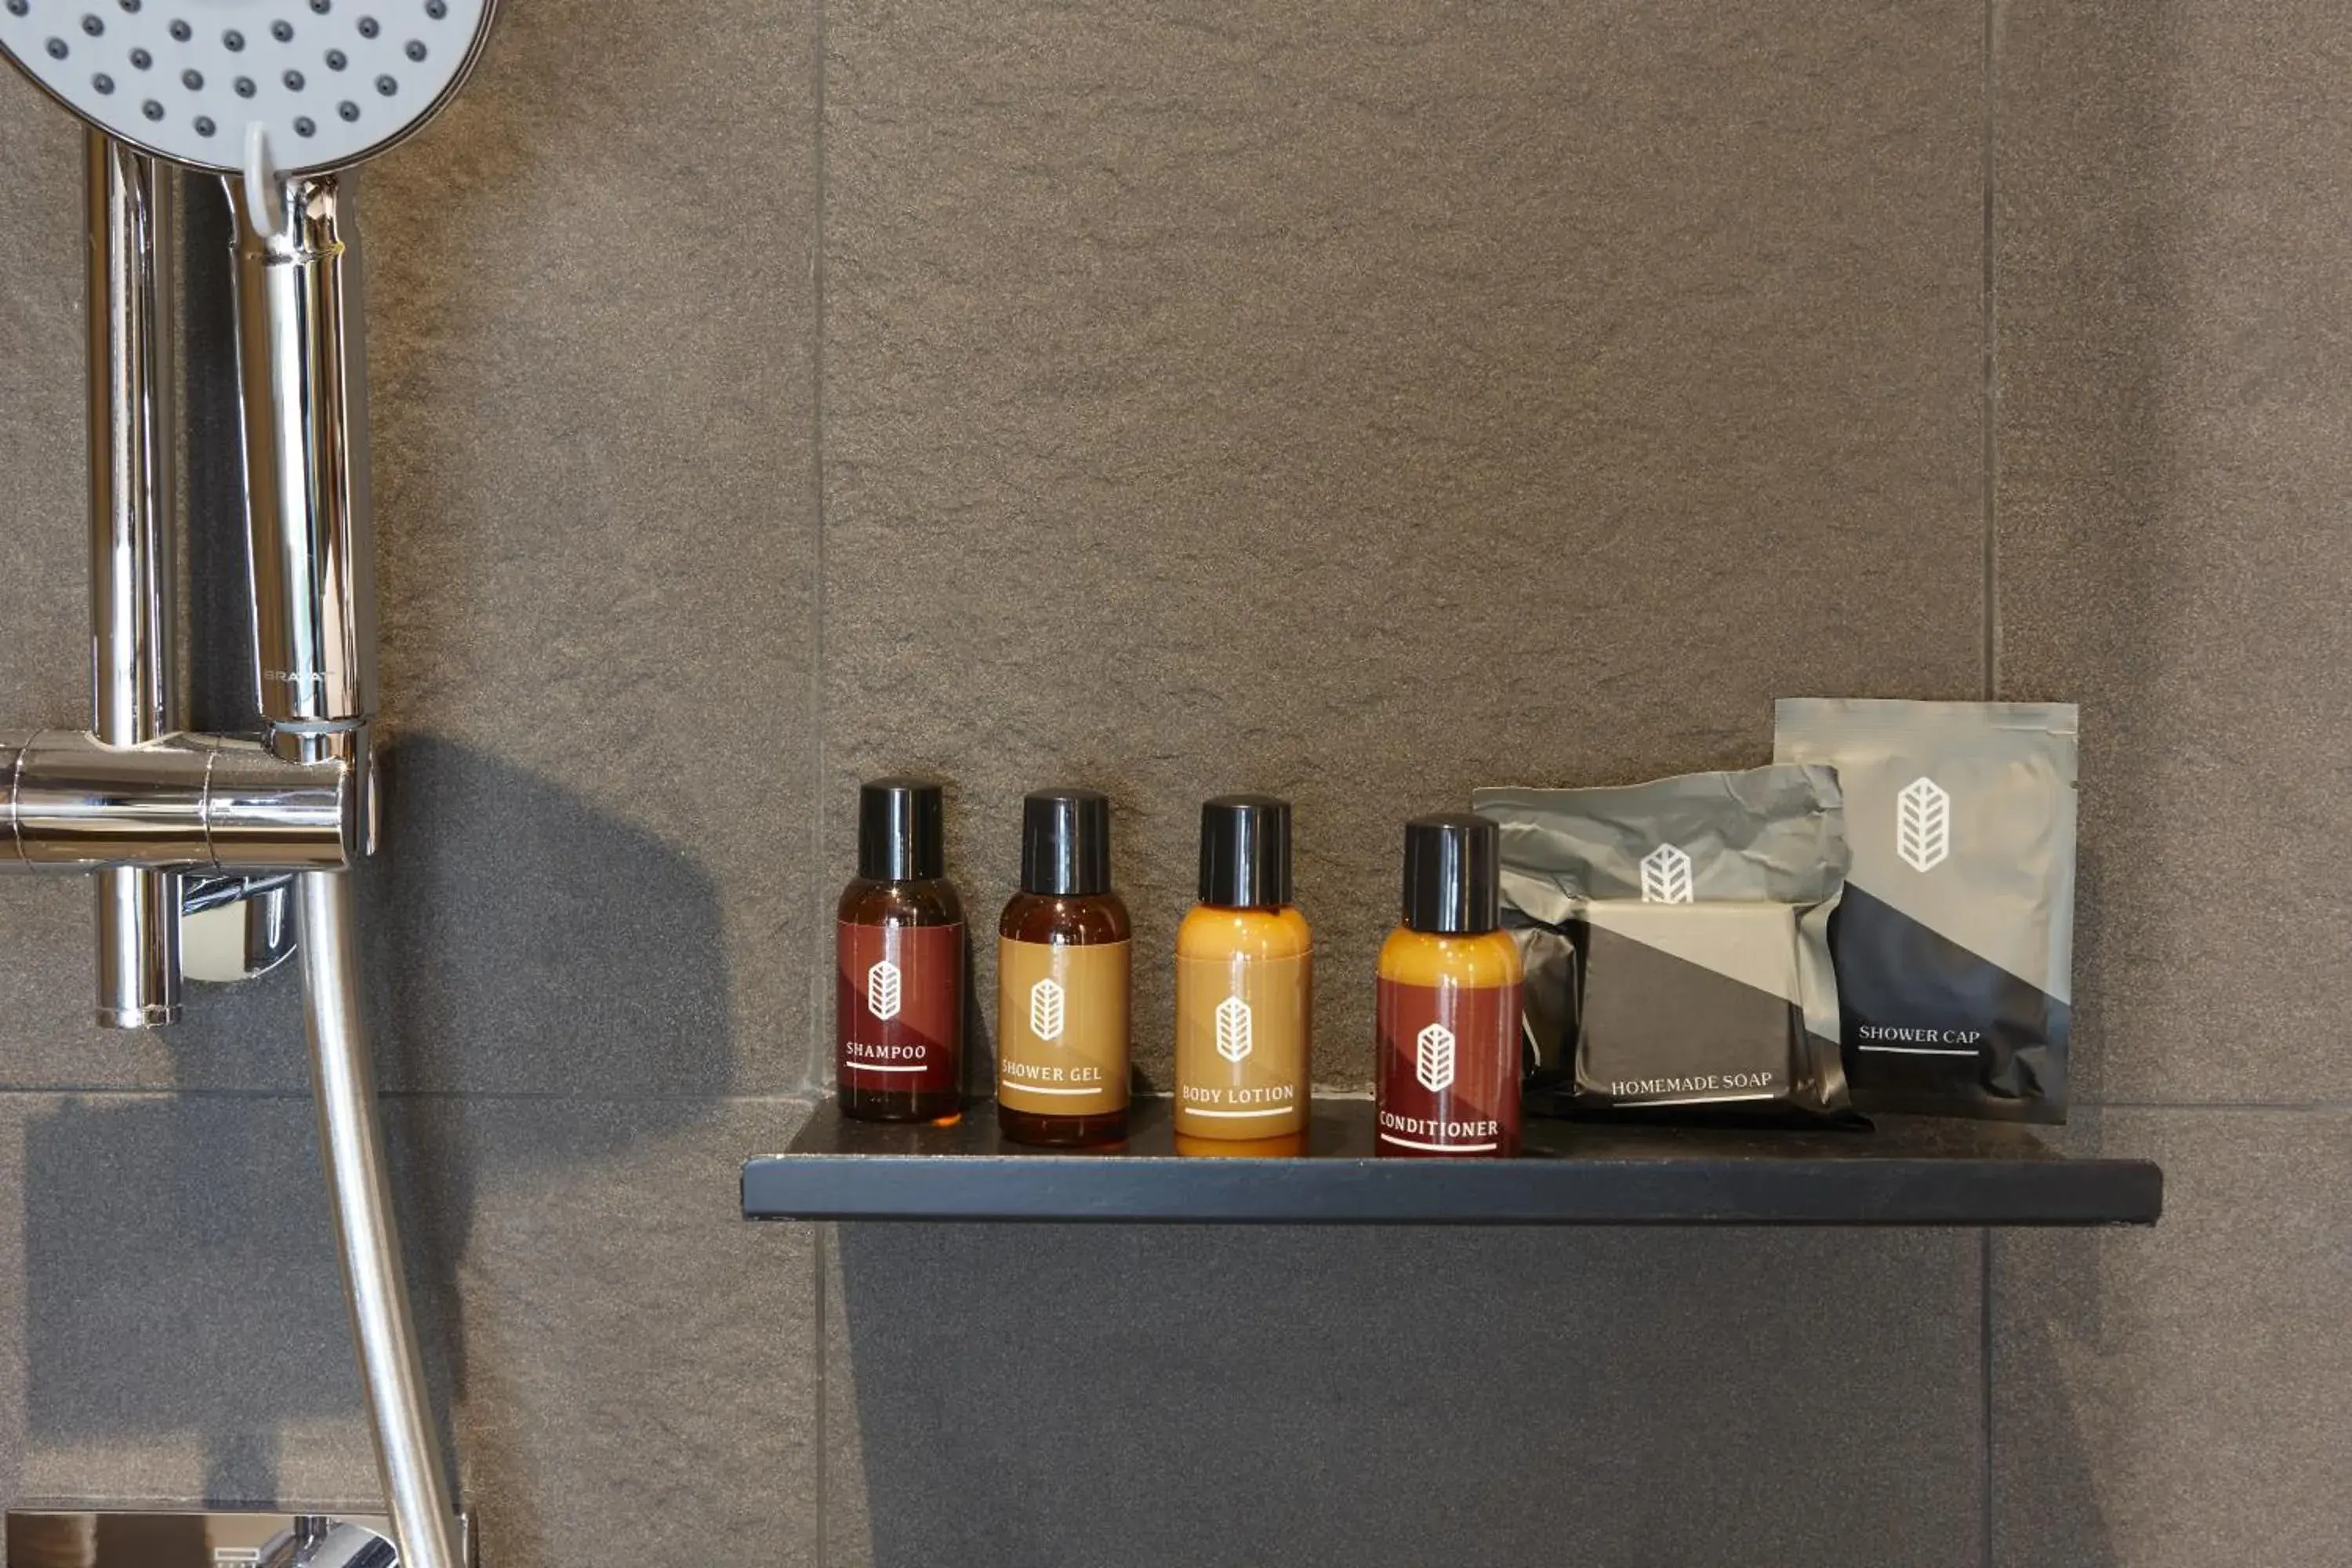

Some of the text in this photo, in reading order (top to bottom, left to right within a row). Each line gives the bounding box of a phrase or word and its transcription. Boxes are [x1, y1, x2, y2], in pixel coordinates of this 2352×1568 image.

[263, 670, 336, 683] BRAAT
[1858, 1025, 1980, 1044] SHOWER CAP
[847, 1041, 926, 1059] SHAMPOO
[1003, 1059, 1102, 1081] SHOWER GEL
[1611, 1072, 1773, 1095] HOMEMADE SOAP
[1182, 1084, 1293, 1104] BODY LOTION
[1380, 1110, 1498, 1138] CONDITIONER
